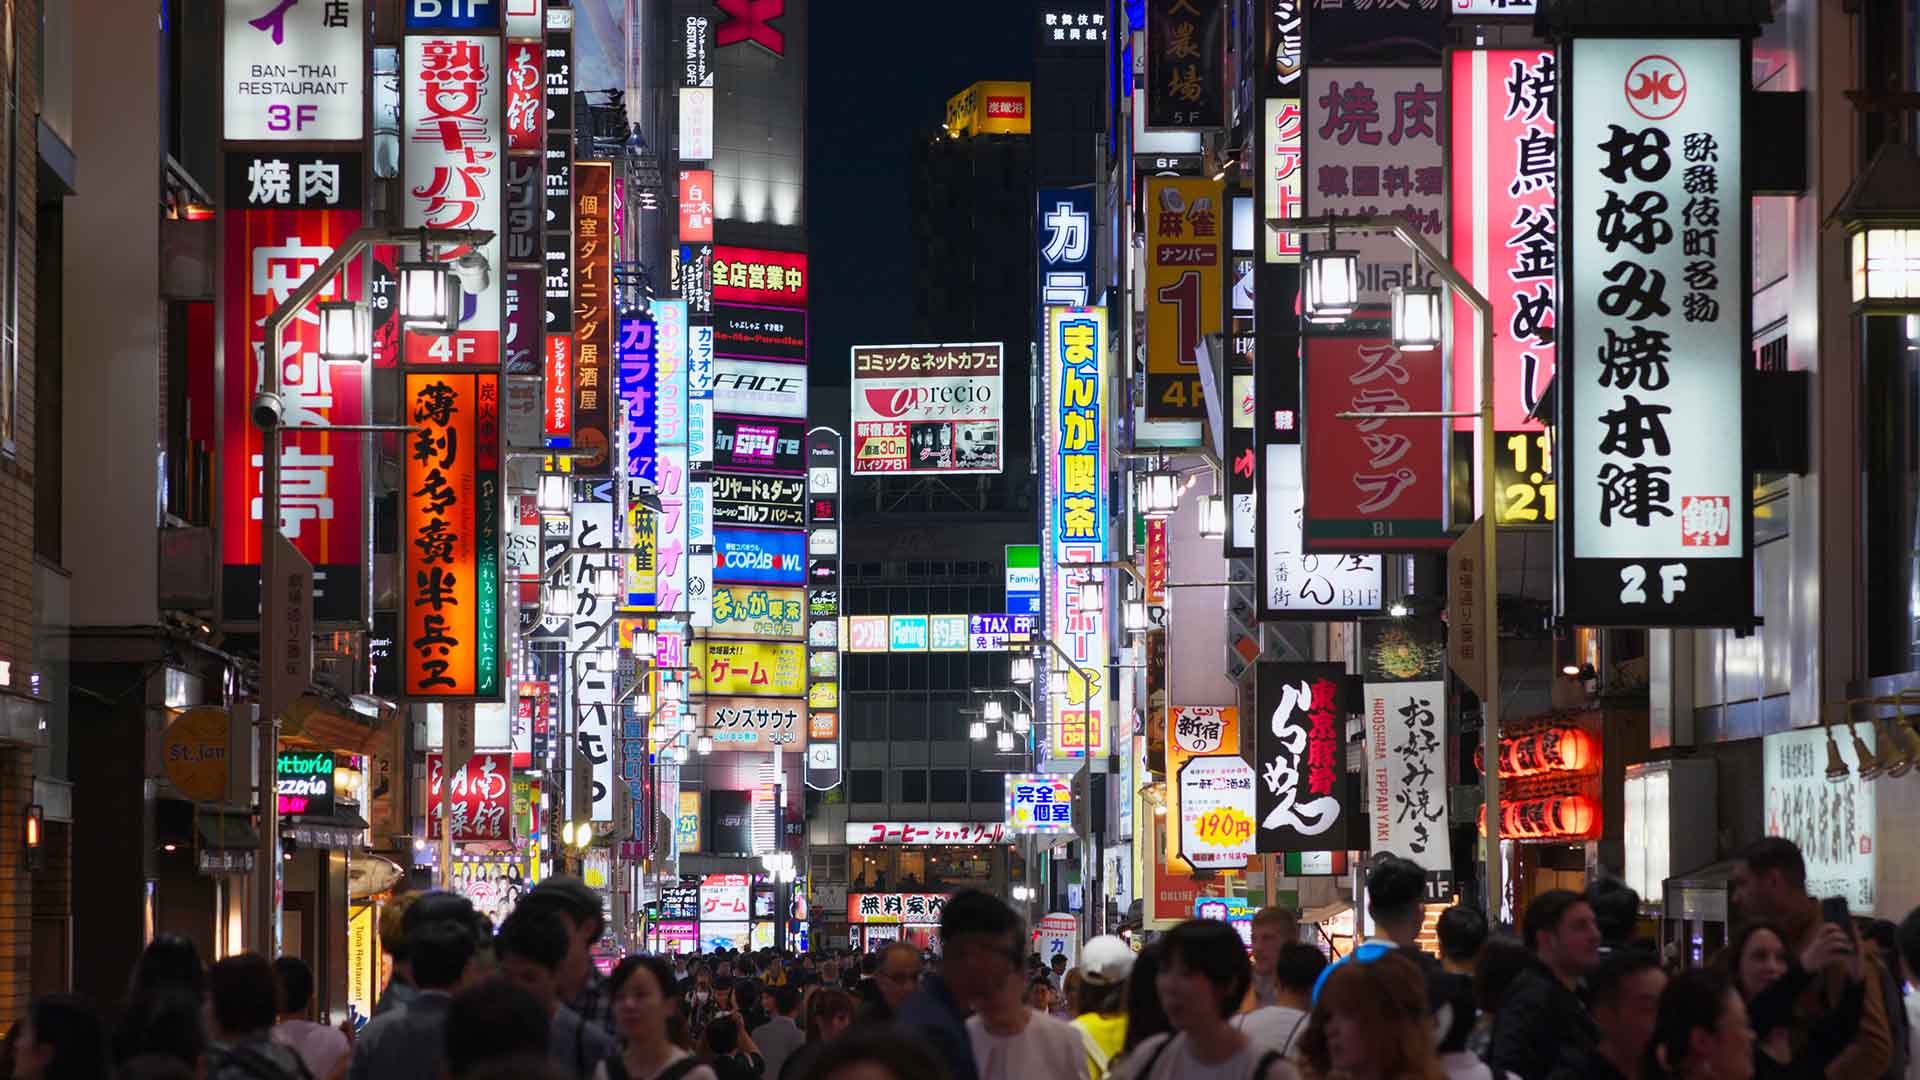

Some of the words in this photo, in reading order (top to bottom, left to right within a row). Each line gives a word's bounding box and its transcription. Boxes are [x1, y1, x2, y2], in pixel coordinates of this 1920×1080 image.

[251, 65, 337, 78] BAN-THAI
[239, 82, 349, 95] RESTAURANT
[267, 105, 318, 131] 3F
[1156, 158, 1178, 168] 6F
[248, 160, 340, 204] 焼肉
[1159, 211, 1216, 238] 麻雀
[1161, 248, 1214, 262] ナンバー
[712, 260, 803, 293] 全店営業中
[579, 195, 599, 410] 個室ダイニング居酒屋
[428, 336, 476, 362] 4F
[697, 327, 712, 389] カラオケ
[857, 352, 998, 371] コミック&ネットカフェ
[621, 319, 652, 451] カラオケ
[714, 373, 804, 393] FACE
[891, 379, 991, 413] aprecio
[690, 402, 704, 457] SEGA
[1061, 321, 1098, 541] まんが喫茶
[1351, 344, 1416, 514] ステップ
[690, 462, 702, 470] 2F
[690, 486, 704, 540] SEGA
[738, 505, 769, 522] ゴルフ
[635, 509, 653, 571] 麻雀
[690, 545, 702, 553] 1F
[1009, 574, 1039, 585] Family
[1274, 551, 1291, 606] 一番街
[1620, 563, 1688, 604] 2F
[713, 589, 800, 622] まんが喫茶
[1066, 546, 1096, 662] マボー
[1341, 588, 1379, 606] B1F
[983, 617, 1008, 633] TAX
[976, 636, 1002, 649] 免税
[711, 658, 769, 685] ゲーム
[714, 708, 798, 729] メンズサウナ
[1176, 714, 1221, 741] 新宿
[1371, 698, 1388, 760] HIROSHIMA
[1191, 739, 1207, 751] の
[1308, 678, 1337, 795] 東京豚骨
[1394, 696, 1444, 853] お好み焼き
[1017, 786, 1053, 804] 完全
[1033, 804, 1069, 822] 個室
[1199, 813, 1251, 838] 190円
[869, 824, 930, 842] コーヒー
[973, 824, 1004, 842] クール
[1426, 880, 1449, 898] 1F
[704, 897, 747, 913] ゲーム
[356, 925, 364, 947] Tuna
[356, 949, 364, 1001] Restaurant
